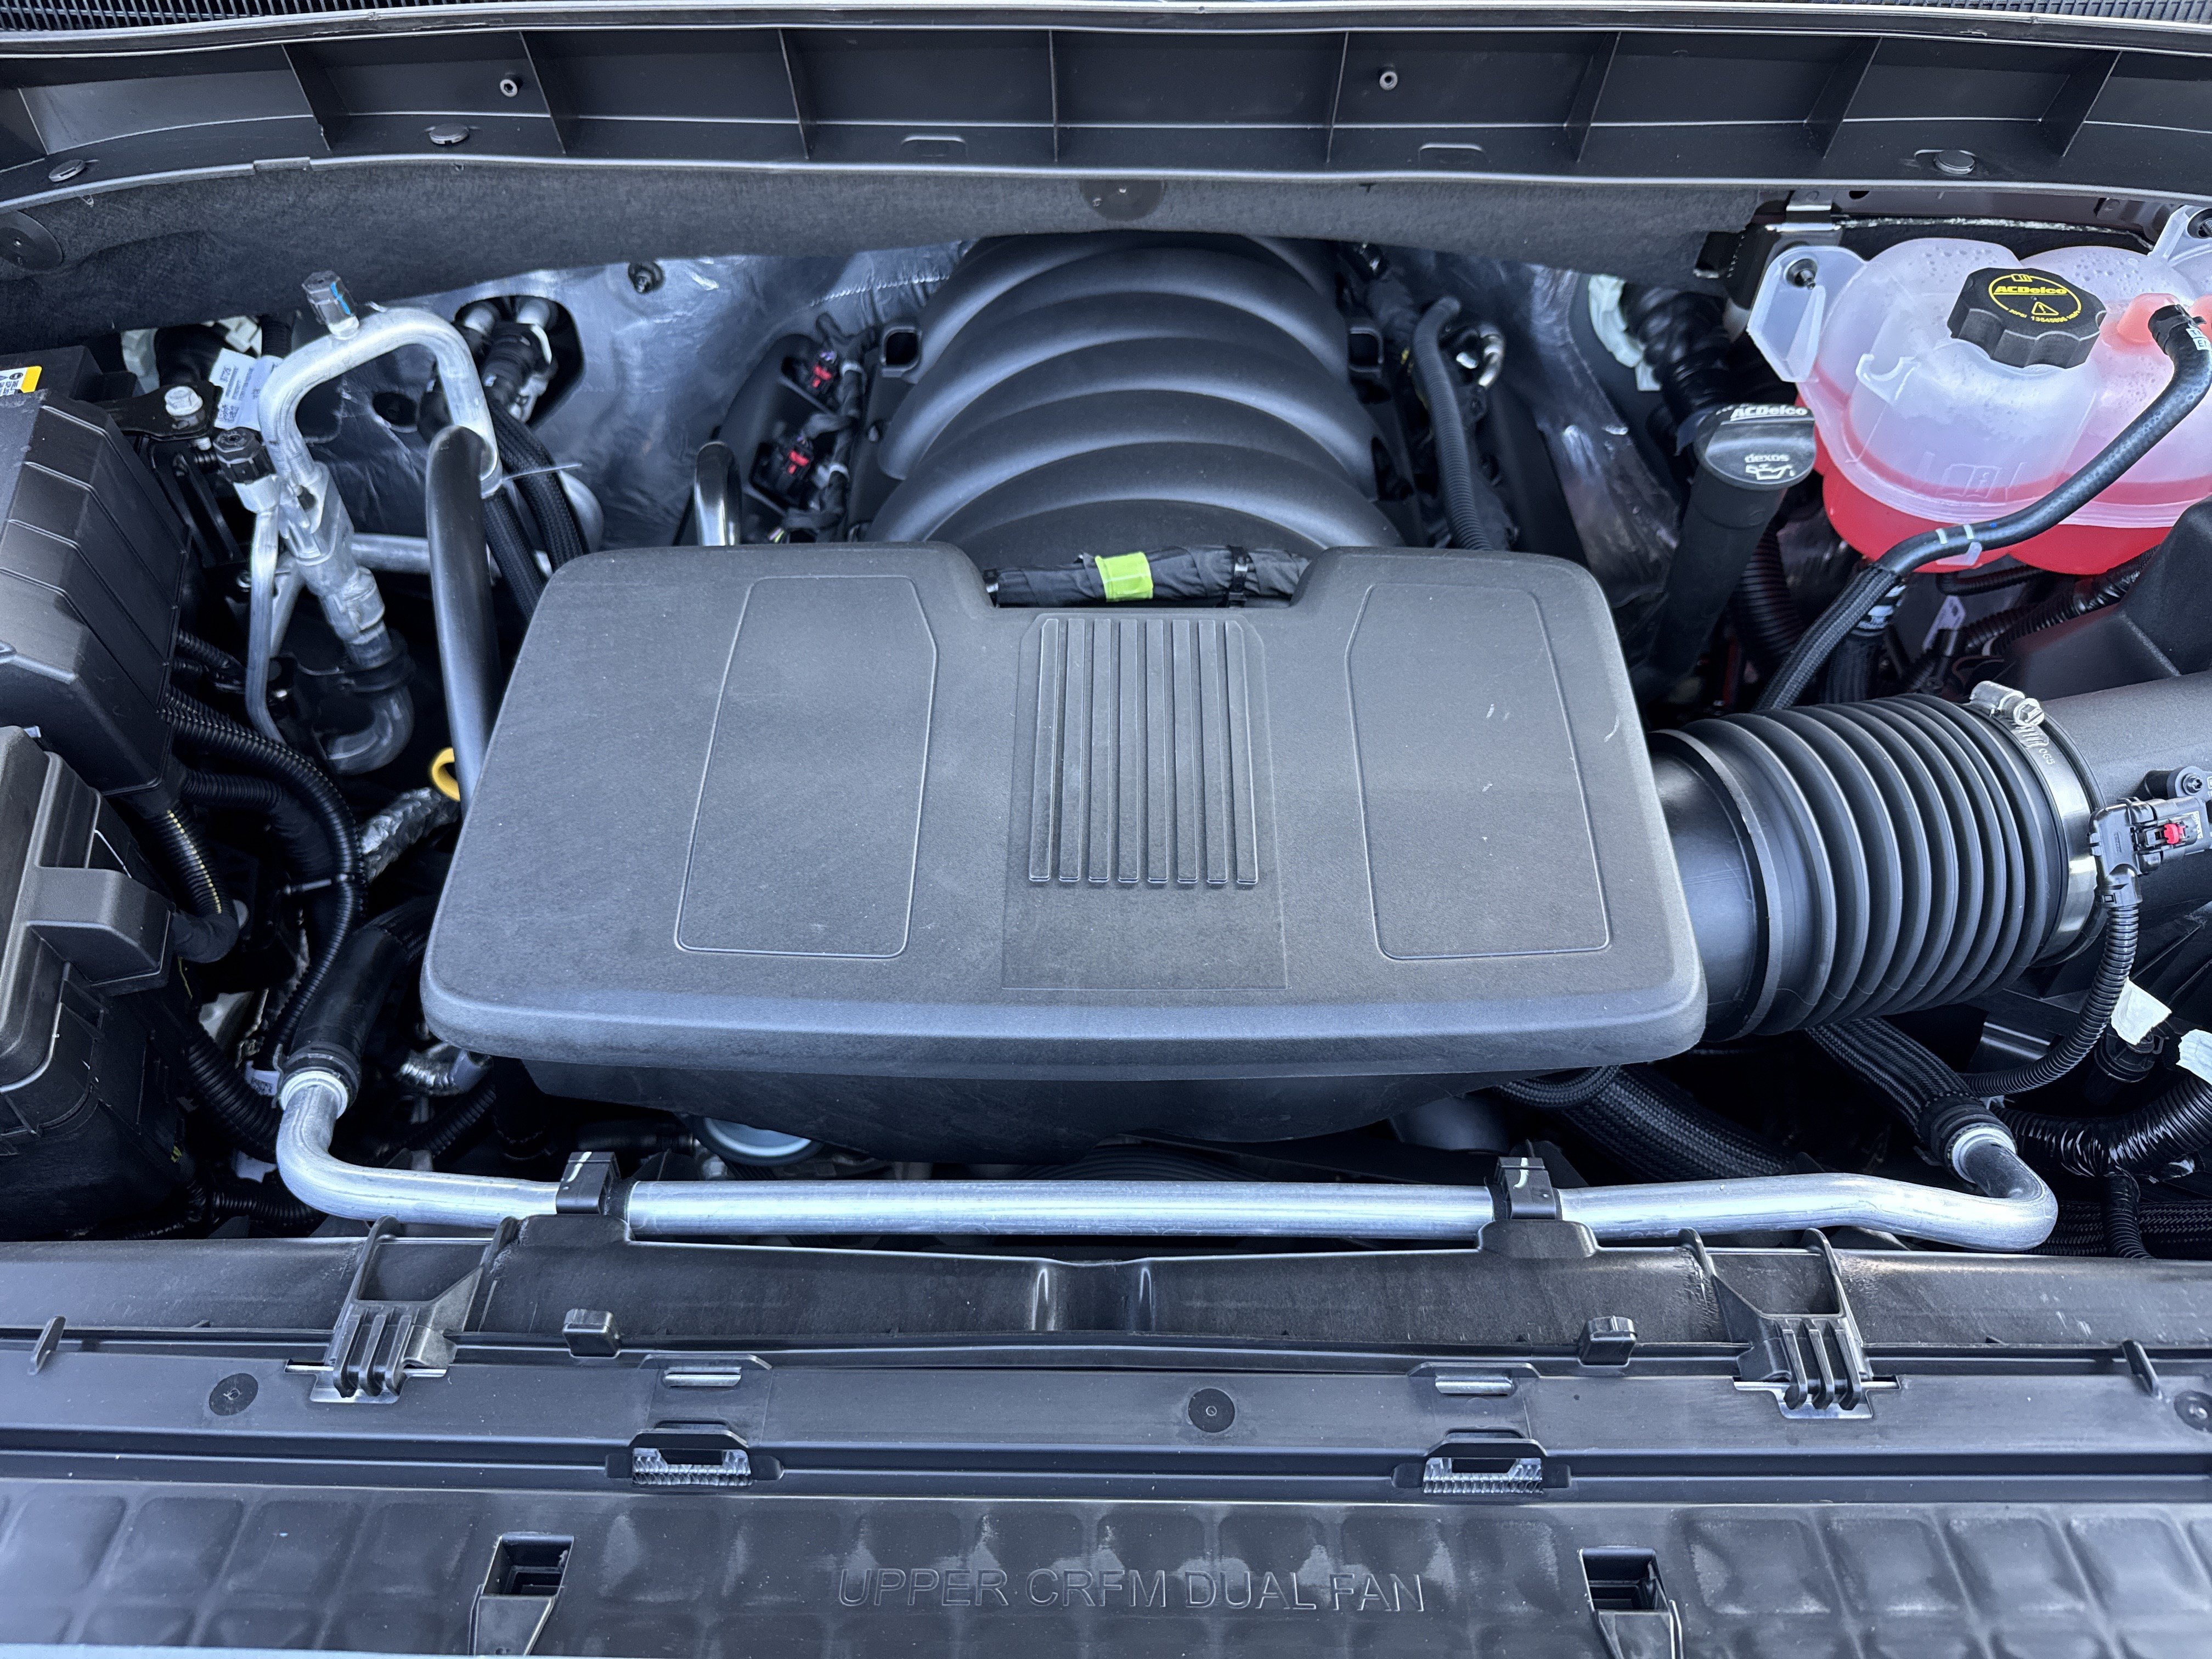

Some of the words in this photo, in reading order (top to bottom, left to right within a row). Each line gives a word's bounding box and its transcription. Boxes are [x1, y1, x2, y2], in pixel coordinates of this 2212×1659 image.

[1994, 286, 2067, 294] ACDelco
[1730, 404, 1808, 419] ACDelco
[1745, 454, 1790, 463] dexos
[839, 1567, 1009, 1606] UPPER
[1025, 1568, 1166, 1607] CRFM
[1184, 1570, 1317, 1610] DUAL
[1329, 1573, 1425, 1612] FAN
